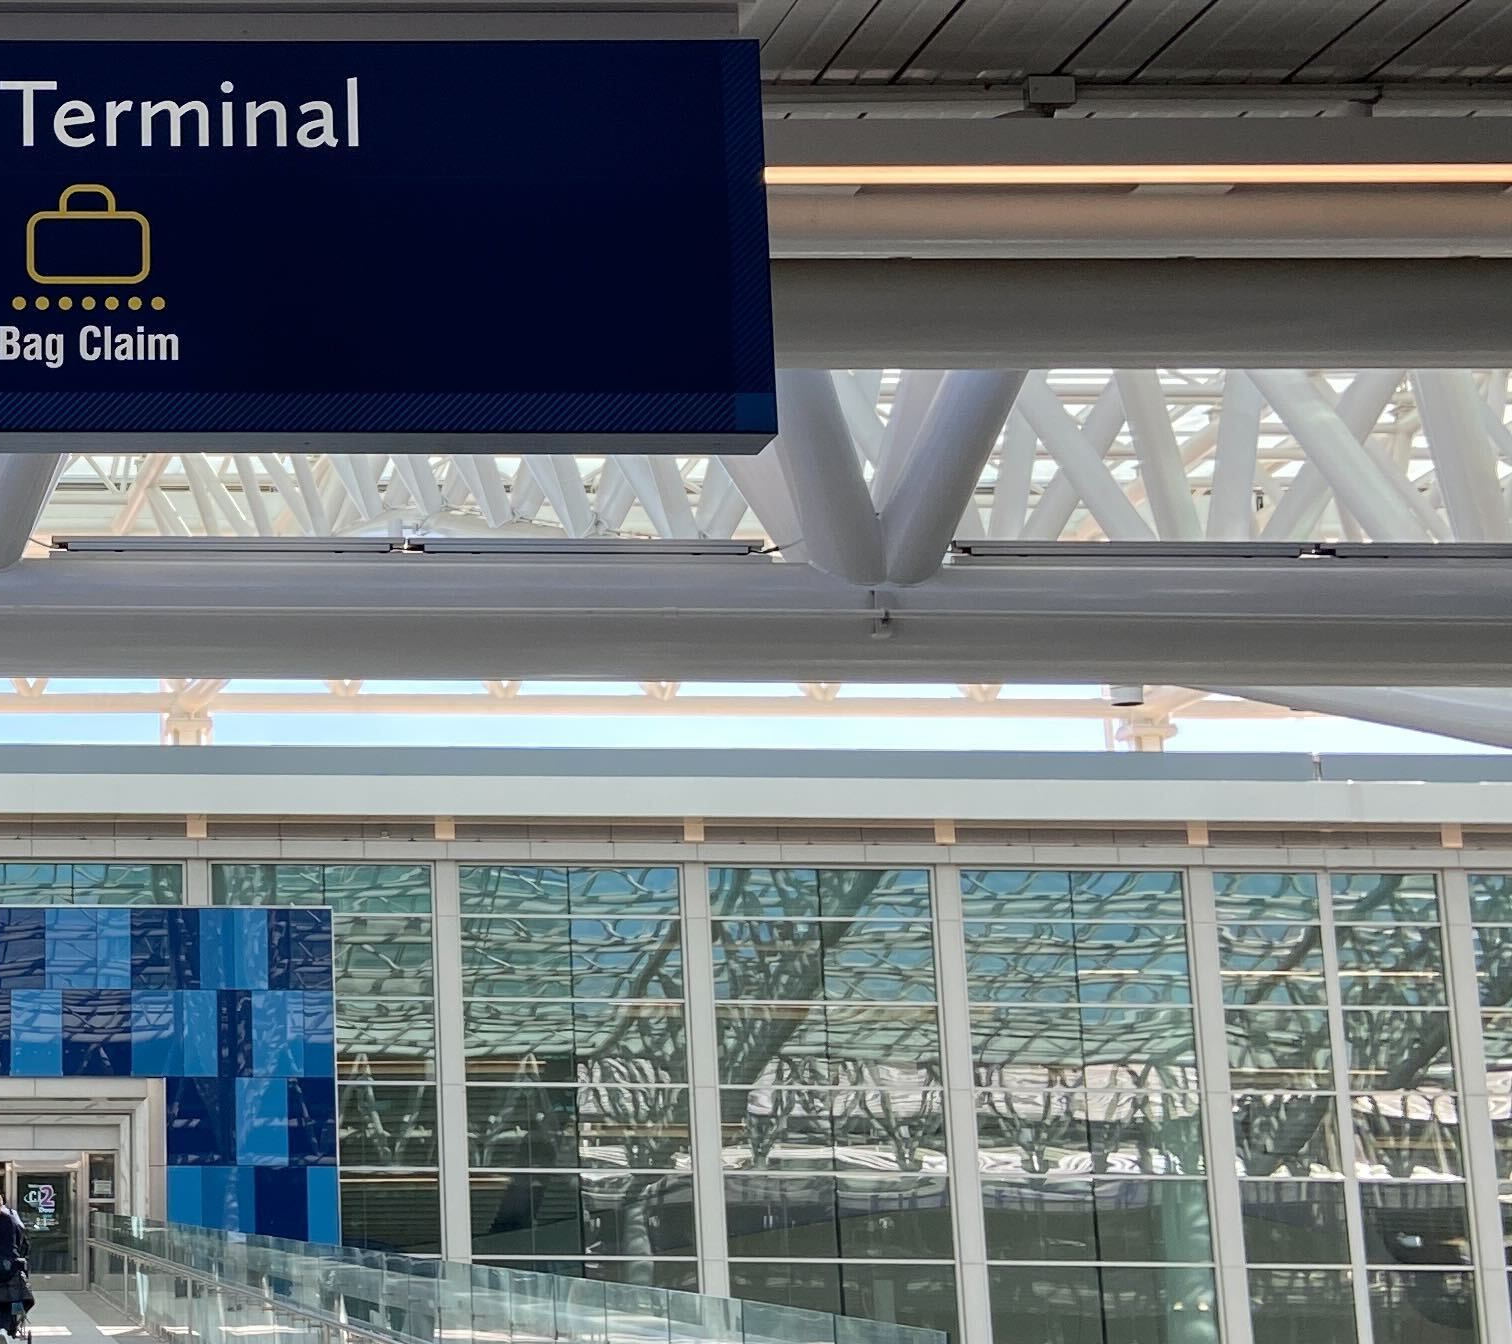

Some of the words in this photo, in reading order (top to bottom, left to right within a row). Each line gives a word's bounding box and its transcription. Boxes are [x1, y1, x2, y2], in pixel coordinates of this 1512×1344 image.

[0, 76, 360, 149] Terminal
[0, 325, 65, 370] Bag
[79, 324, 179, 362] Claim
[39, 1185, 55, 1207] 2
